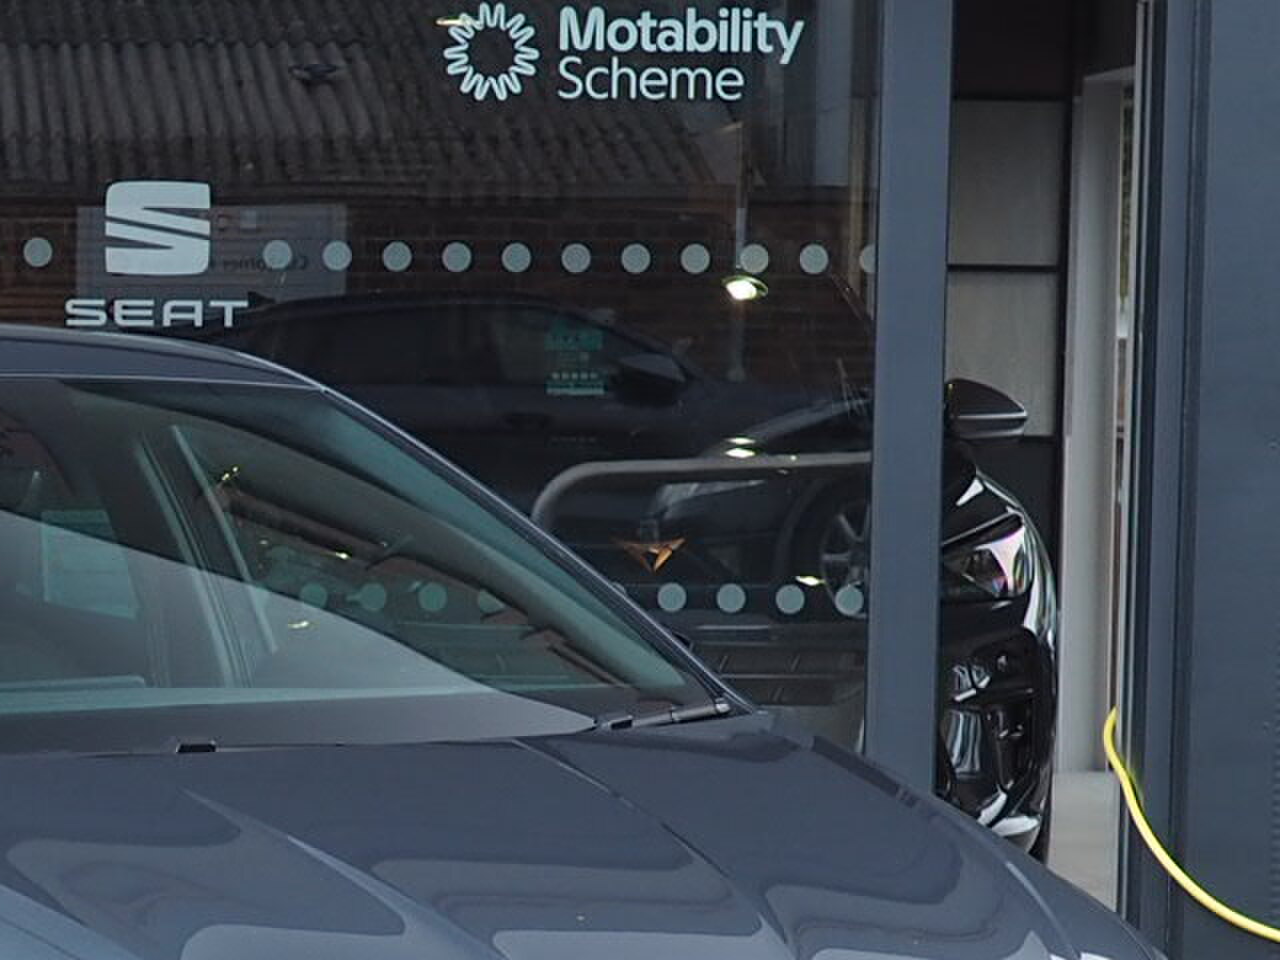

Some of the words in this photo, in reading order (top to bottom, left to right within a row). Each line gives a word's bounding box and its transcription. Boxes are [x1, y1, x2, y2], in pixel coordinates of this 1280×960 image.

[559, 6, 805, 64] Motability
[558, 56, 745, 100] Scheme
[65, 298, 249, 328] SEAT
